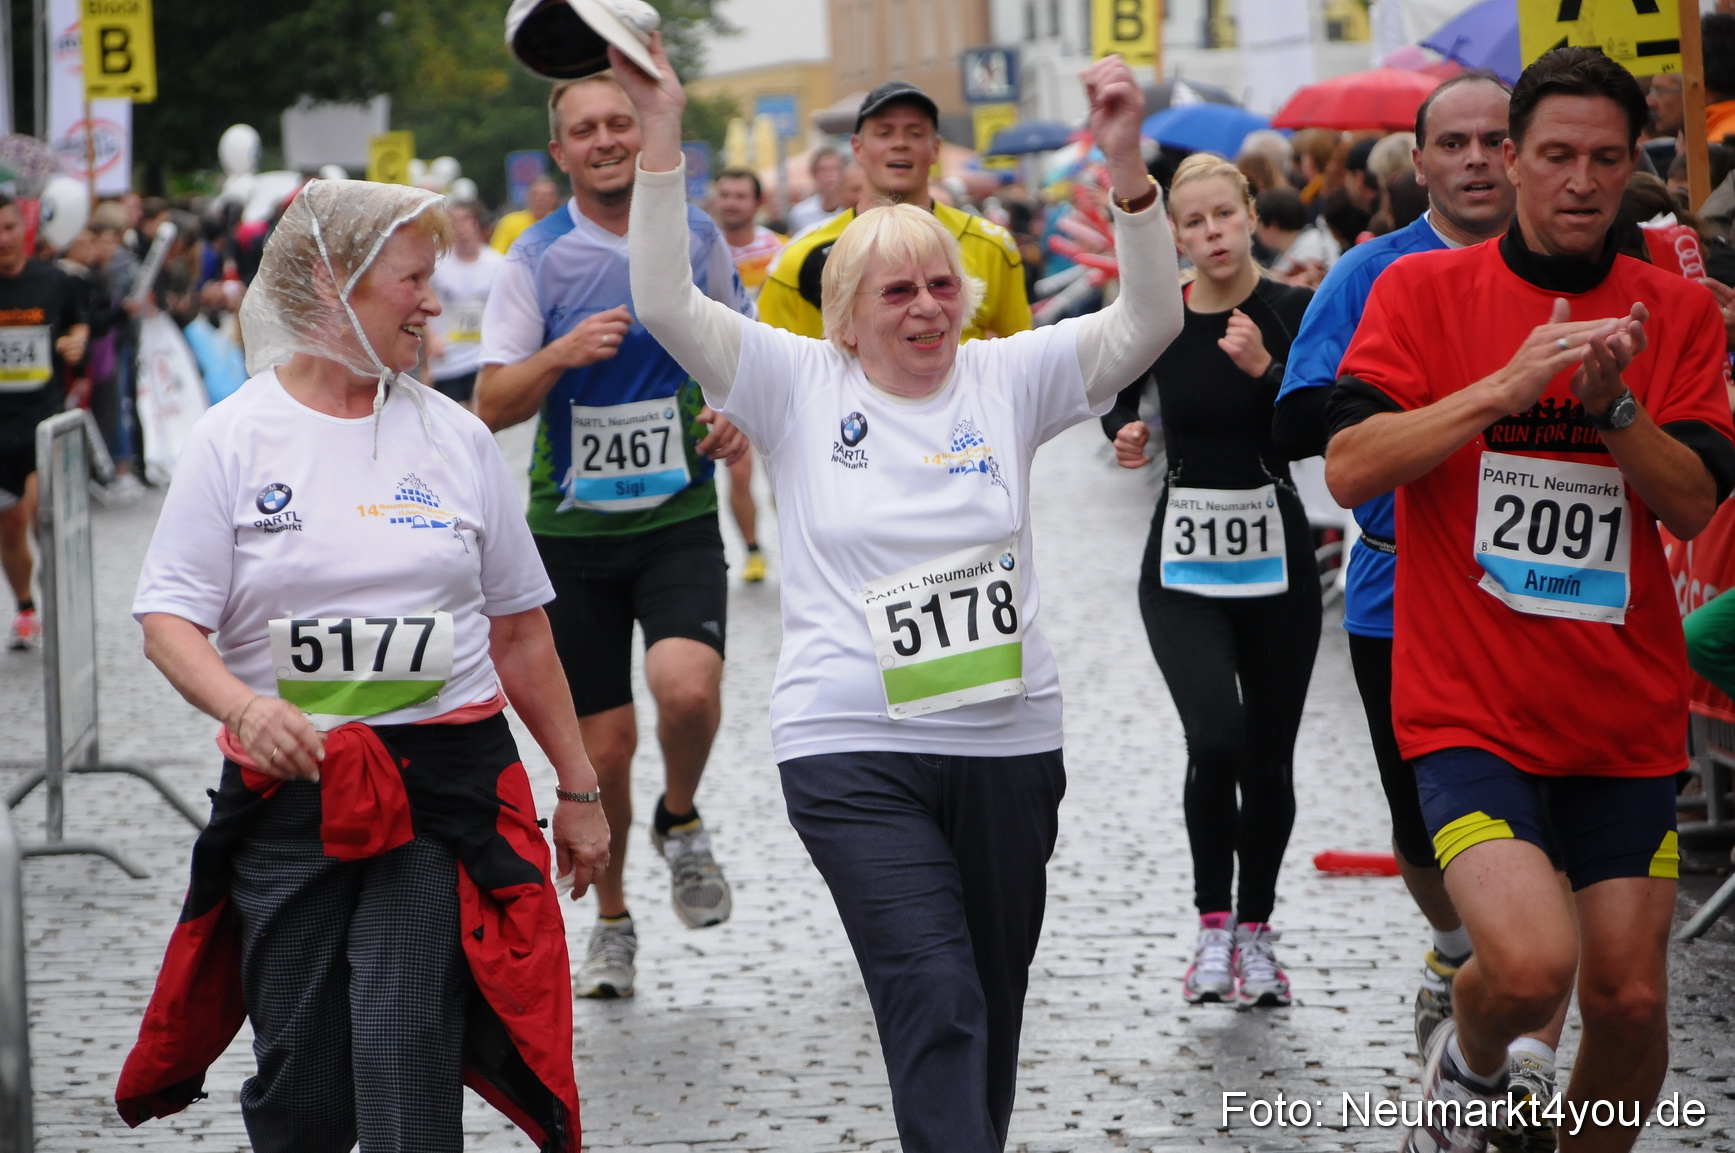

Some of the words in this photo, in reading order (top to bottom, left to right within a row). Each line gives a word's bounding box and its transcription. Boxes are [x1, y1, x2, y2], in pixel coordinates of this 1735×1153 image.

[1113, 0, 1144, 41] B
[100, 27, 133, 74] B
[608, 412, 660, 426] Neumarkt
[1491, 424, 1531, 442] RUN
[1535, 423, 1567, 444] FOR
[582, 426, 670, 471] 2467
[833, 441, 869, 461] PARTL
[615, 479, 646, 497] Sigi
[1483, 468, 1539, 489] PARTL
[1544, 476, 1619, 497] Neumarkt
[356, 504, 385, 517] 14.
[1168, 499, 1203, 511] PARTL
[1206, 500, 1262, 511] Neumarkt
[253, 511, 302, 528] PARTL
[264, 522, 303, 533] Neumarkt
[1493, 494, 1623, 562] 2091
[1174, 515, 1269, 555] 3191
[1481, 541, 1488, 552] B
[865, 581, 920, 605] PARTL
[922, 560, 995, 586] Neumarkt
[1524, 569, 1581, 597] Armin
[885, 580, 1018, 657] 5178
[290, 617, 436, 673] 5177
